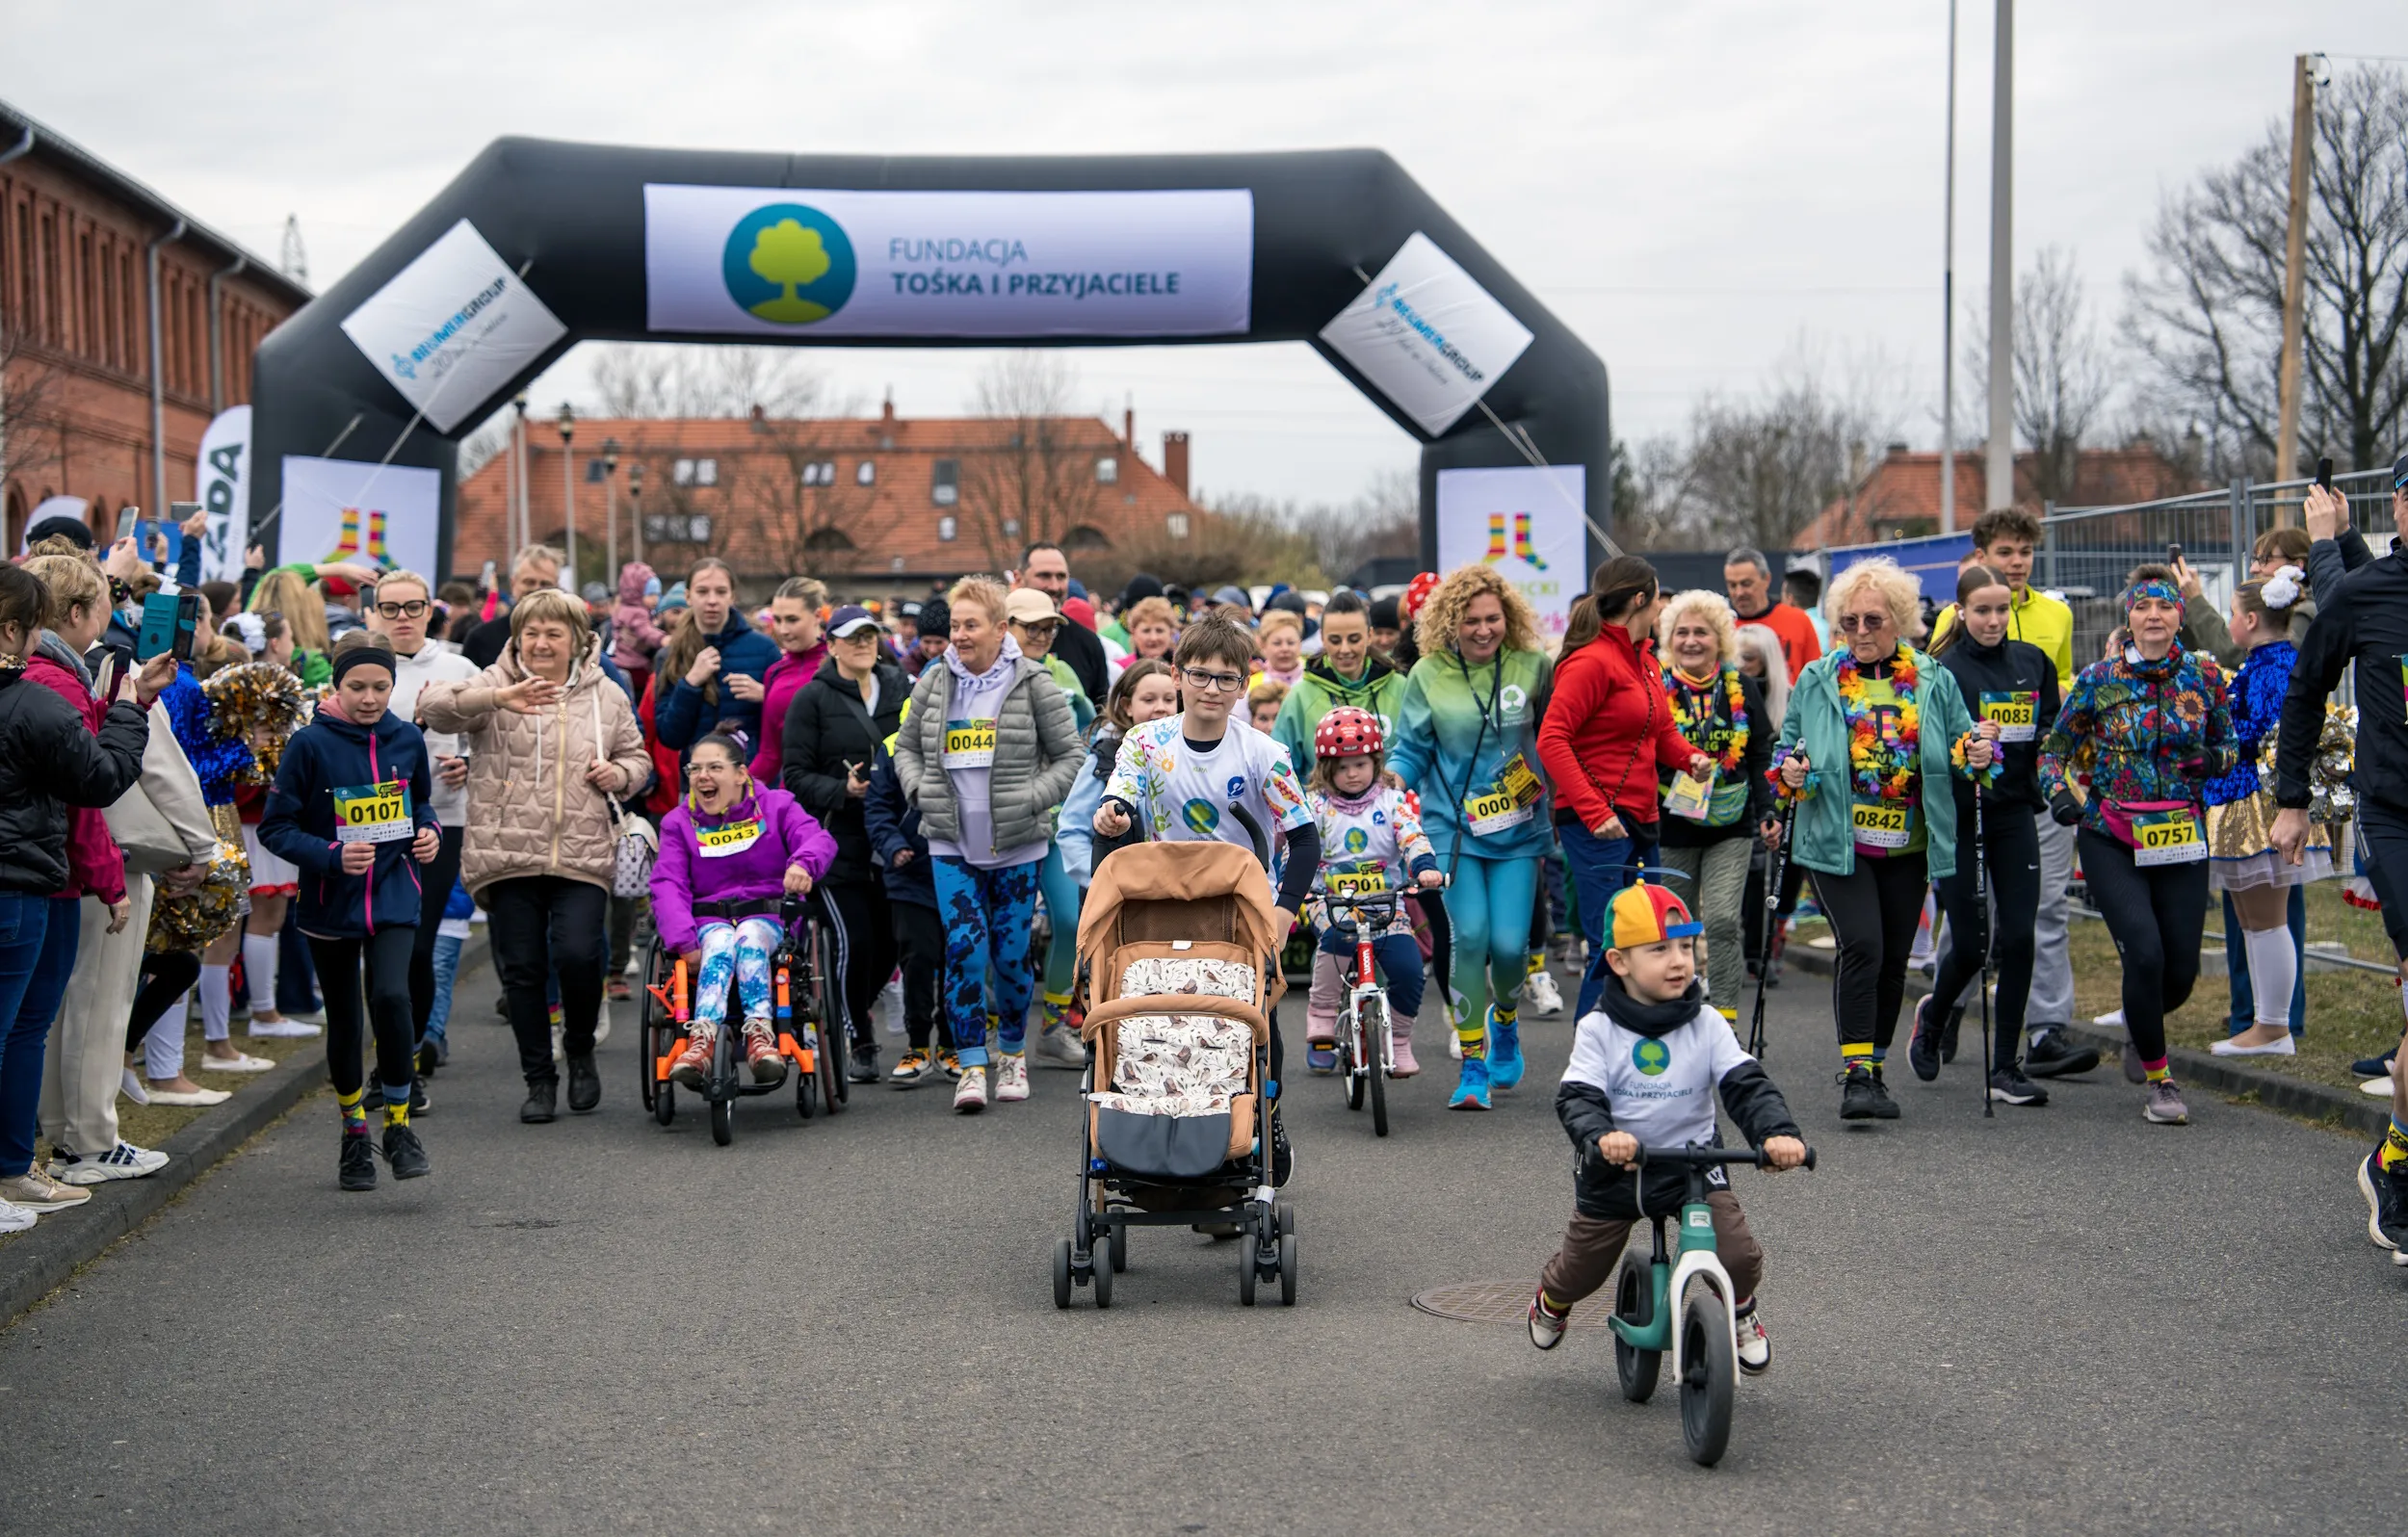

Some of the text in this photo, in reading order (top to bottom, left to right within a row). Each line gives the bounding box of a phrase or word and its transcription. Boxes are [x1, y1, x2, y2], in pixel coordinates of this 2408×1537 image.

[888, 238, 1028, 268] FUNDACJA
[891, 269, 1181, 300] TOŚKA I PRZYJACIELE
[205, 443, 244, 582] ADA
[1991, 709, 2030, 723] 0083
[951, 734, 995, 750] 0044
[350, 800, 401, 823] 0107
[1478, 796, 1511, 817] 000
[1854, 811, 1902, 829] 0842
[710, 828, 755, 846] 0043
[2146, 826, 2193, 847] 0757
[1363, 948, 1373, 976] woom
[1630, 1081, 1673, 1091] FUNDACJA
